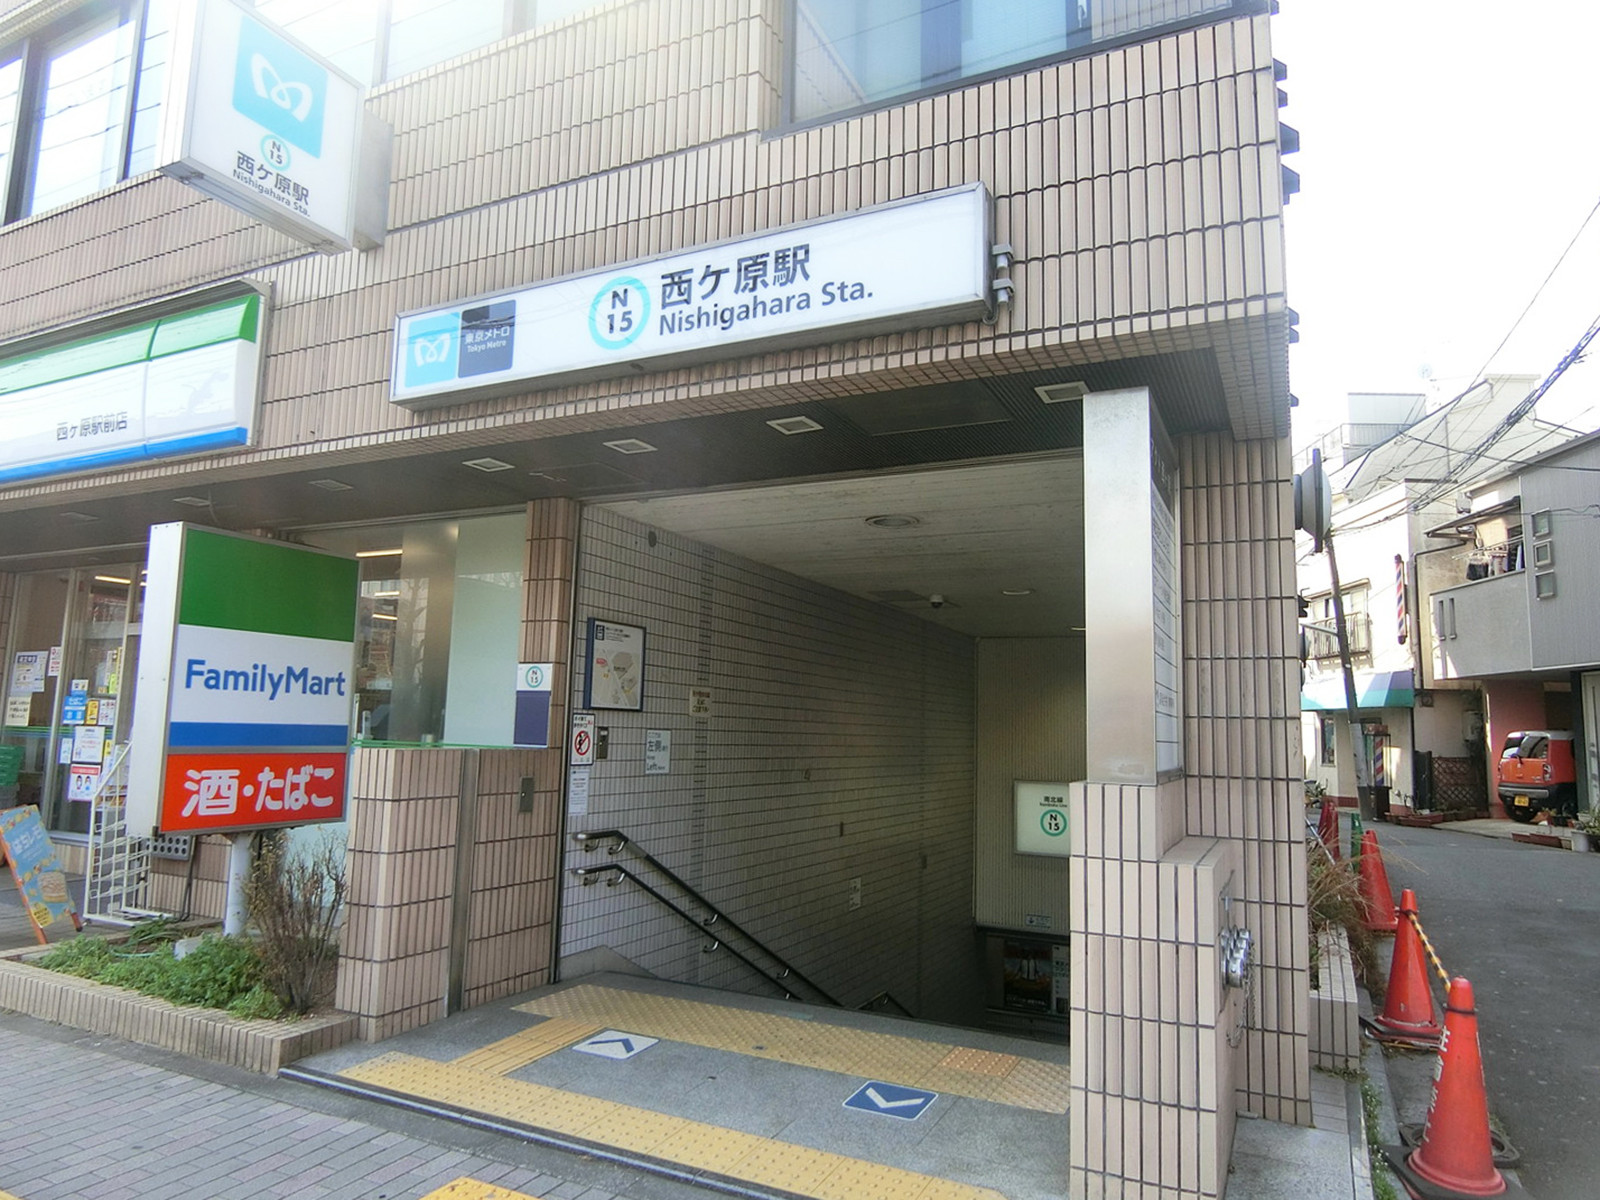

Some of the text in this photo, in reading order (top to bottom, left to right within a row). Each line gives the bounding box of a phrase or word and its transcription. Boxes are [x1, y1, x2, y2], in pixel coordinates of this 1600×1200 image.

[272, 140, 281, 152] N
[270, 149, 283, 164] 15
[232, 168, 311, 217] Nishigahara Sta.
[611, 288, 629, 310] N
[659, 280, 874, 336] Nishigahara Sta.
[606, 310, 634, 335] 15
[467, 344, 486, 353] Tokyo
[185, 658, 346, 701] FamilyMart
[530, 676, 539, 684] 15
[181, 764, 335, 818] 酒・たばこ
[1049, 813, 1058, 821] N
[1048, 822, 1060, 831] 15
